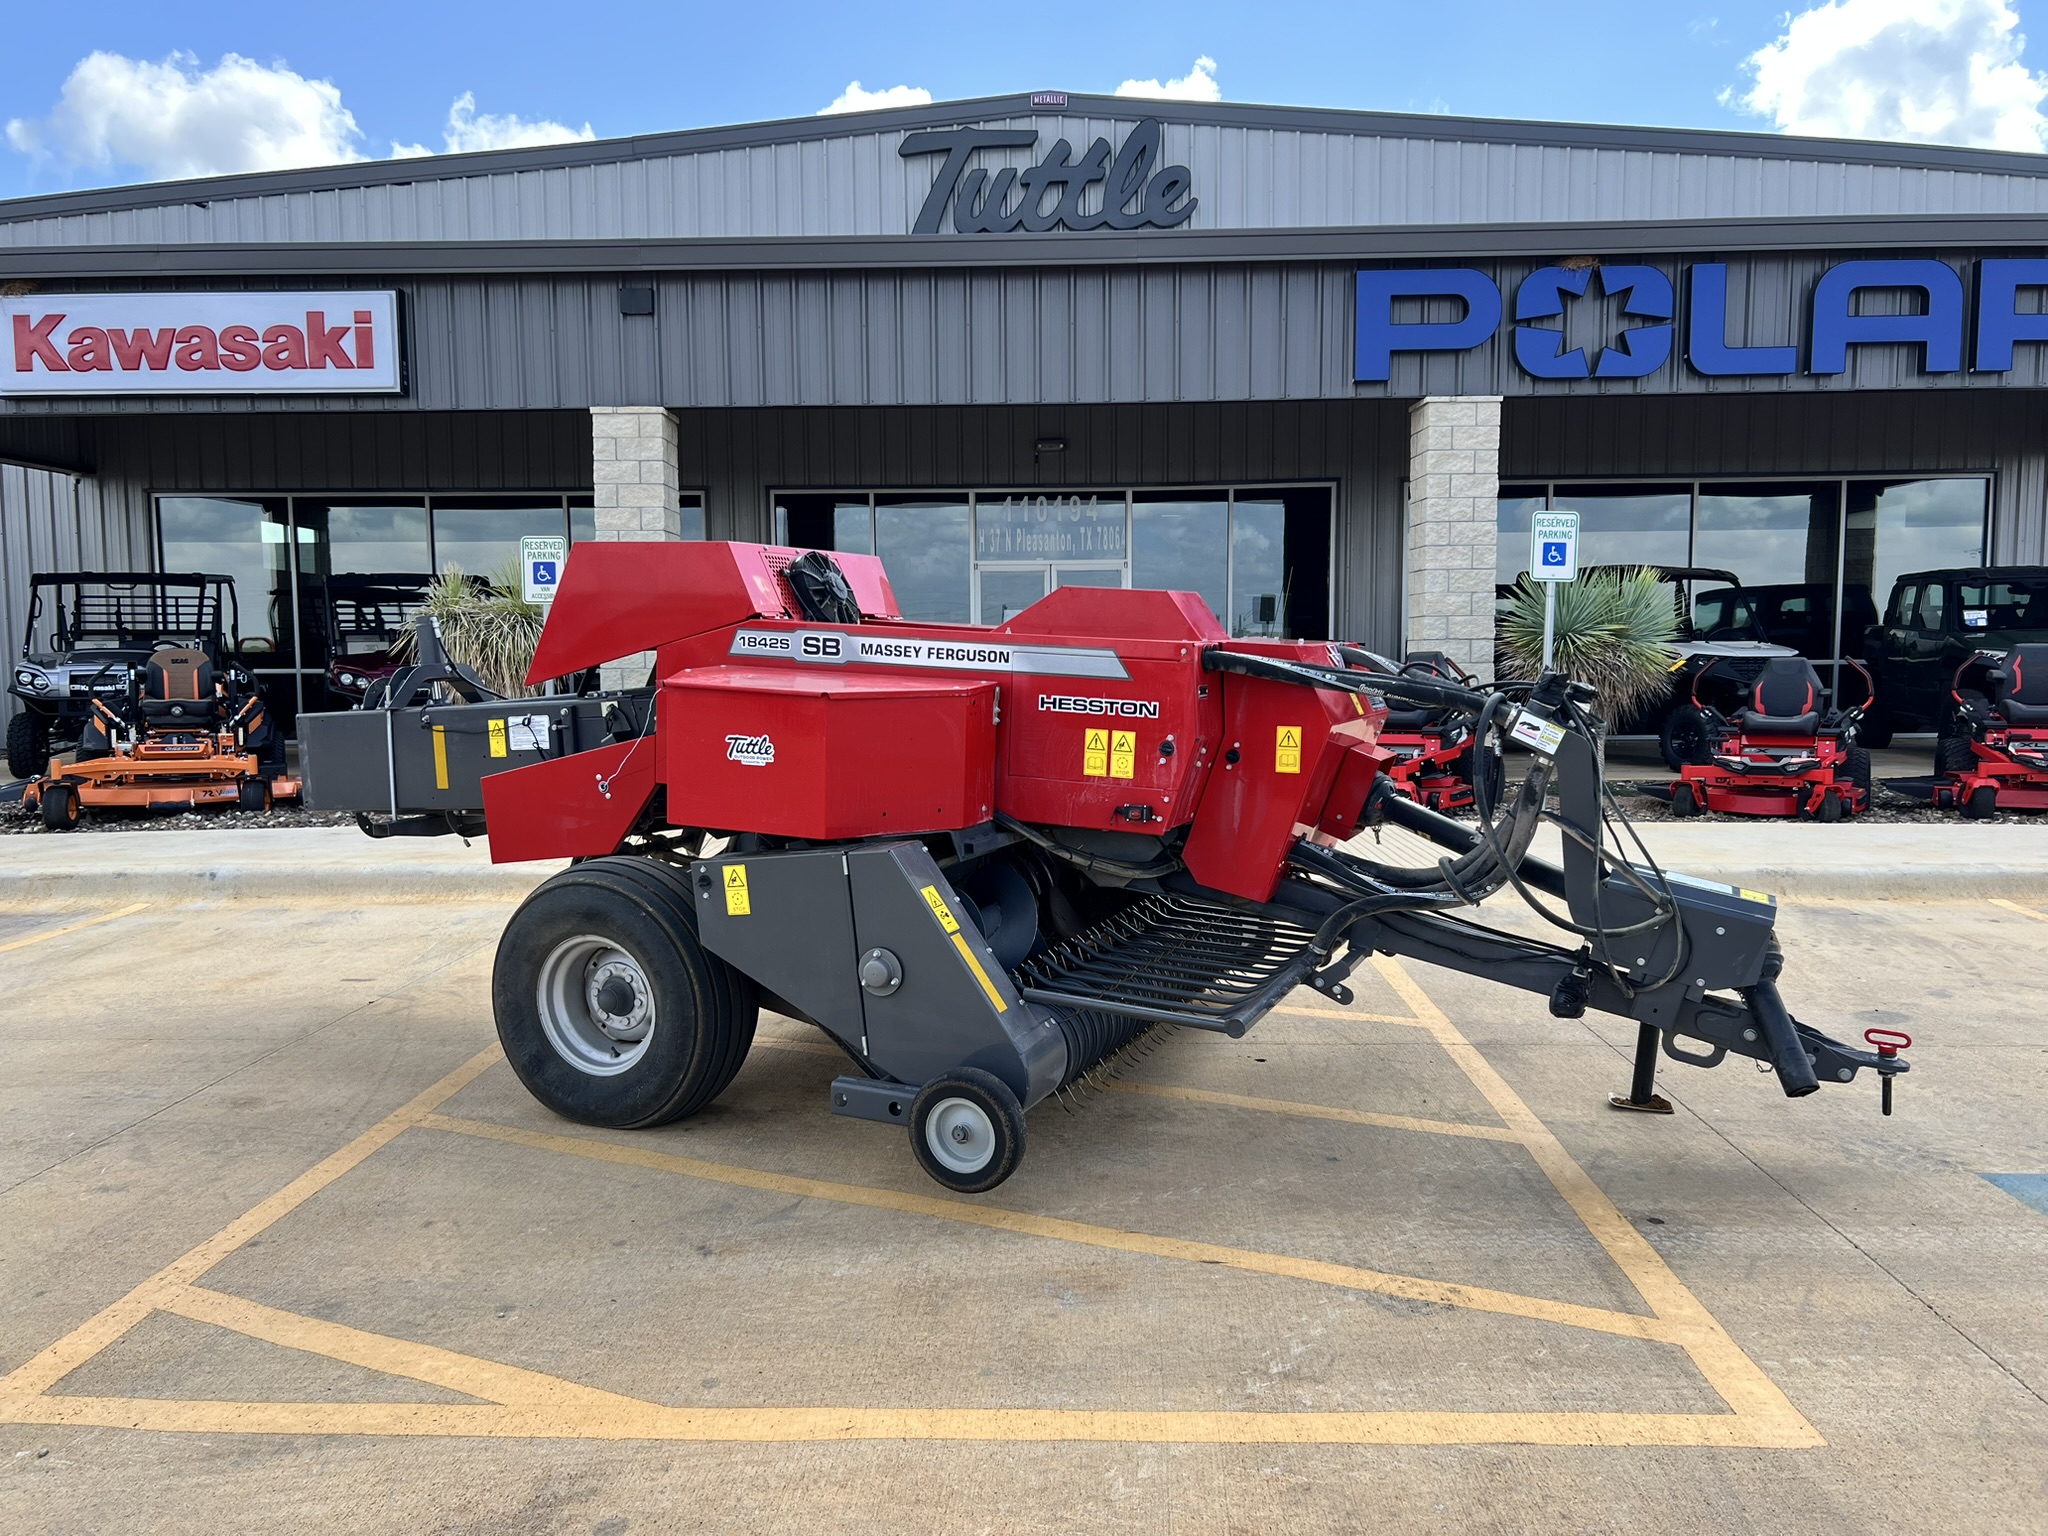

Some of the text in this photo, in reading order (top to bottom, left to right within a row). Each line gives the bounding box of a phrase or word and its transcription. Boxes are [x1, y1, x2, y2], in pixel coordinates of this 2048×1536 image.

[1033, 94, 1065, 104] METALLIC
[898, 117, 1198, 235] Tuttle
[12, 311, 374, 372] Kawasaki
[1003, 495, 1099, 522] 110194
[1536, 518, 1576, 527] RESERVED
[524, 541, 563, 550] RESERVED
[989, 528, 1001, 552] 37
[1005, 528, 1012, 552] N
[1016, 528, 1076, 556] Pleasanton,
[1080, 526, 1093, 551] TX
[1538, 530, 1573, 540] PARKING
[527, 551, 561, 560] PARKING
[738, 635, 1010, 663] 1842S SB MASSEY FERGUSON
[1039, 695, 1158, 717] HESSTON
[727, 736, 773, 758] Tuttle
